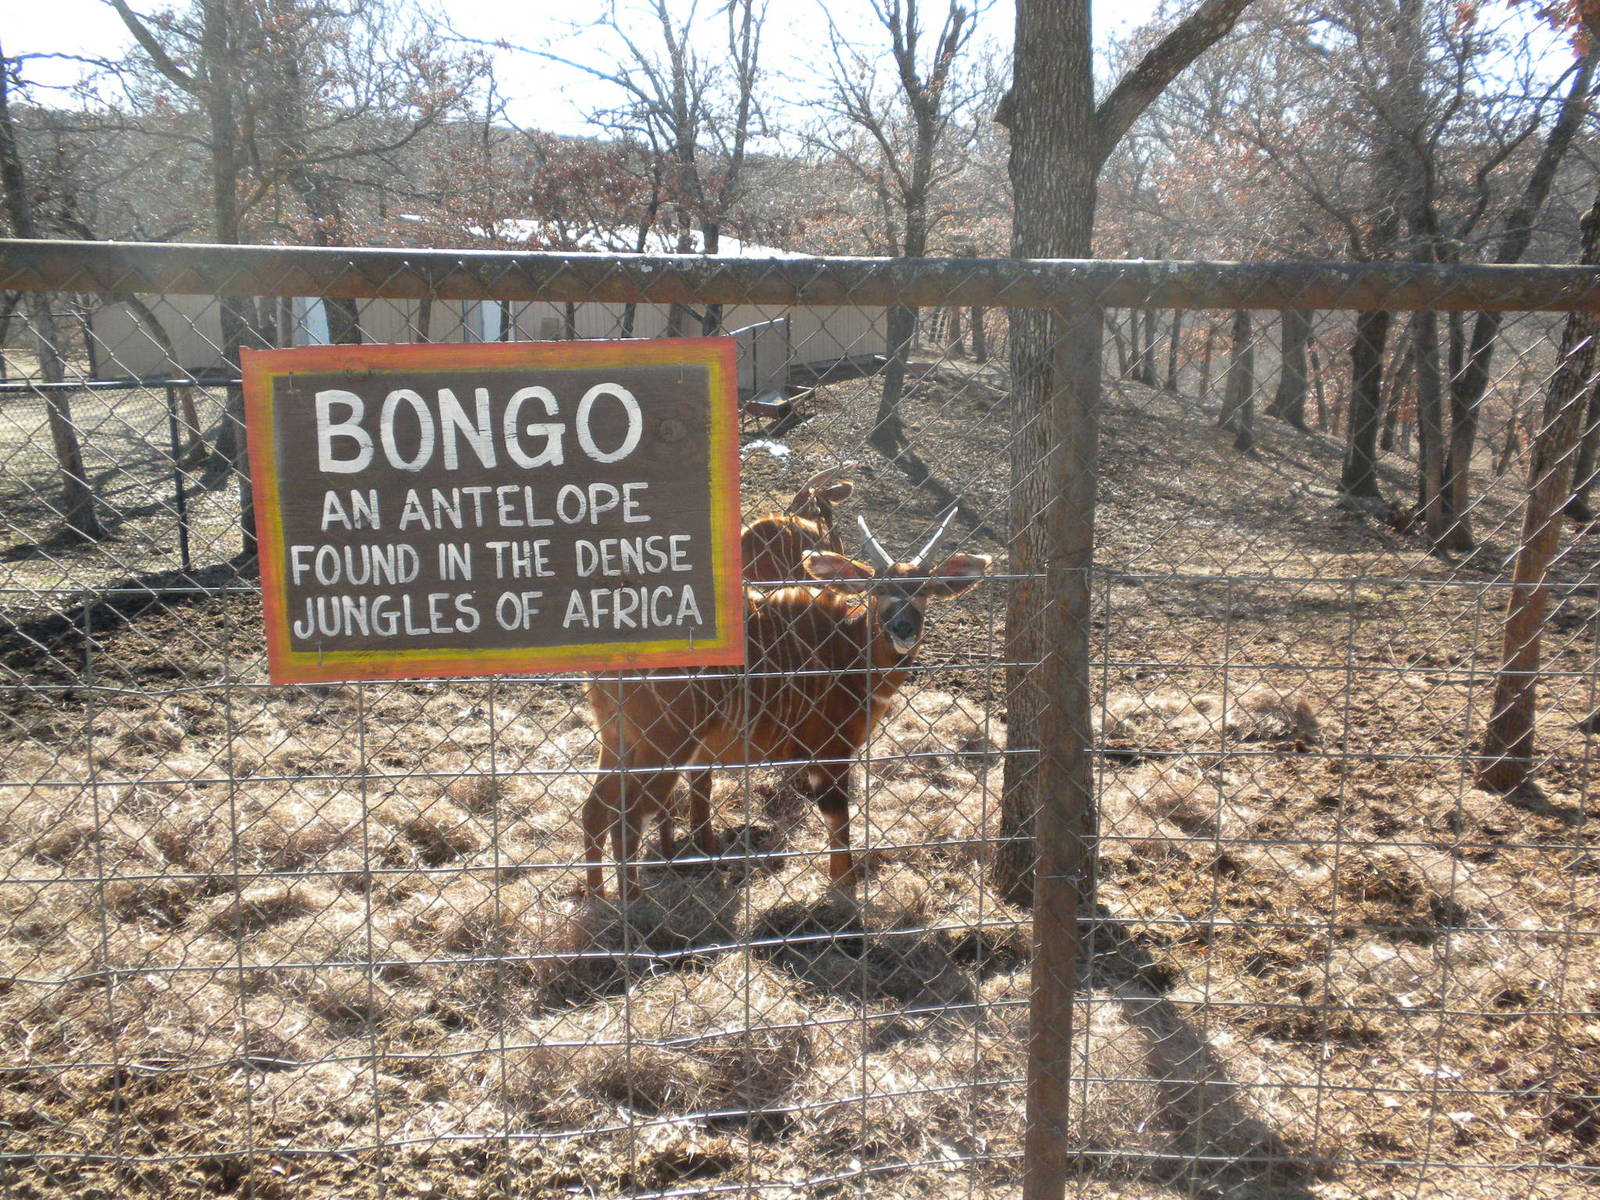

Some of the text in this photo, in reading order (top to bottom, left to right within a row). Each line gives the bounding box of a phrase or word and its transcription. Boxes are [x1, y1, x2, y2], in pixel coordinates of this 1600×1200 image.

[315, 383, 642, 473] BONGO
[321, 482, 651, 531] AN ANTELOPE
[291, 535, 692, 585] FOUND IN THE DENSE
[294, 585, 702, 639] JUNGLES OF AFRICA
